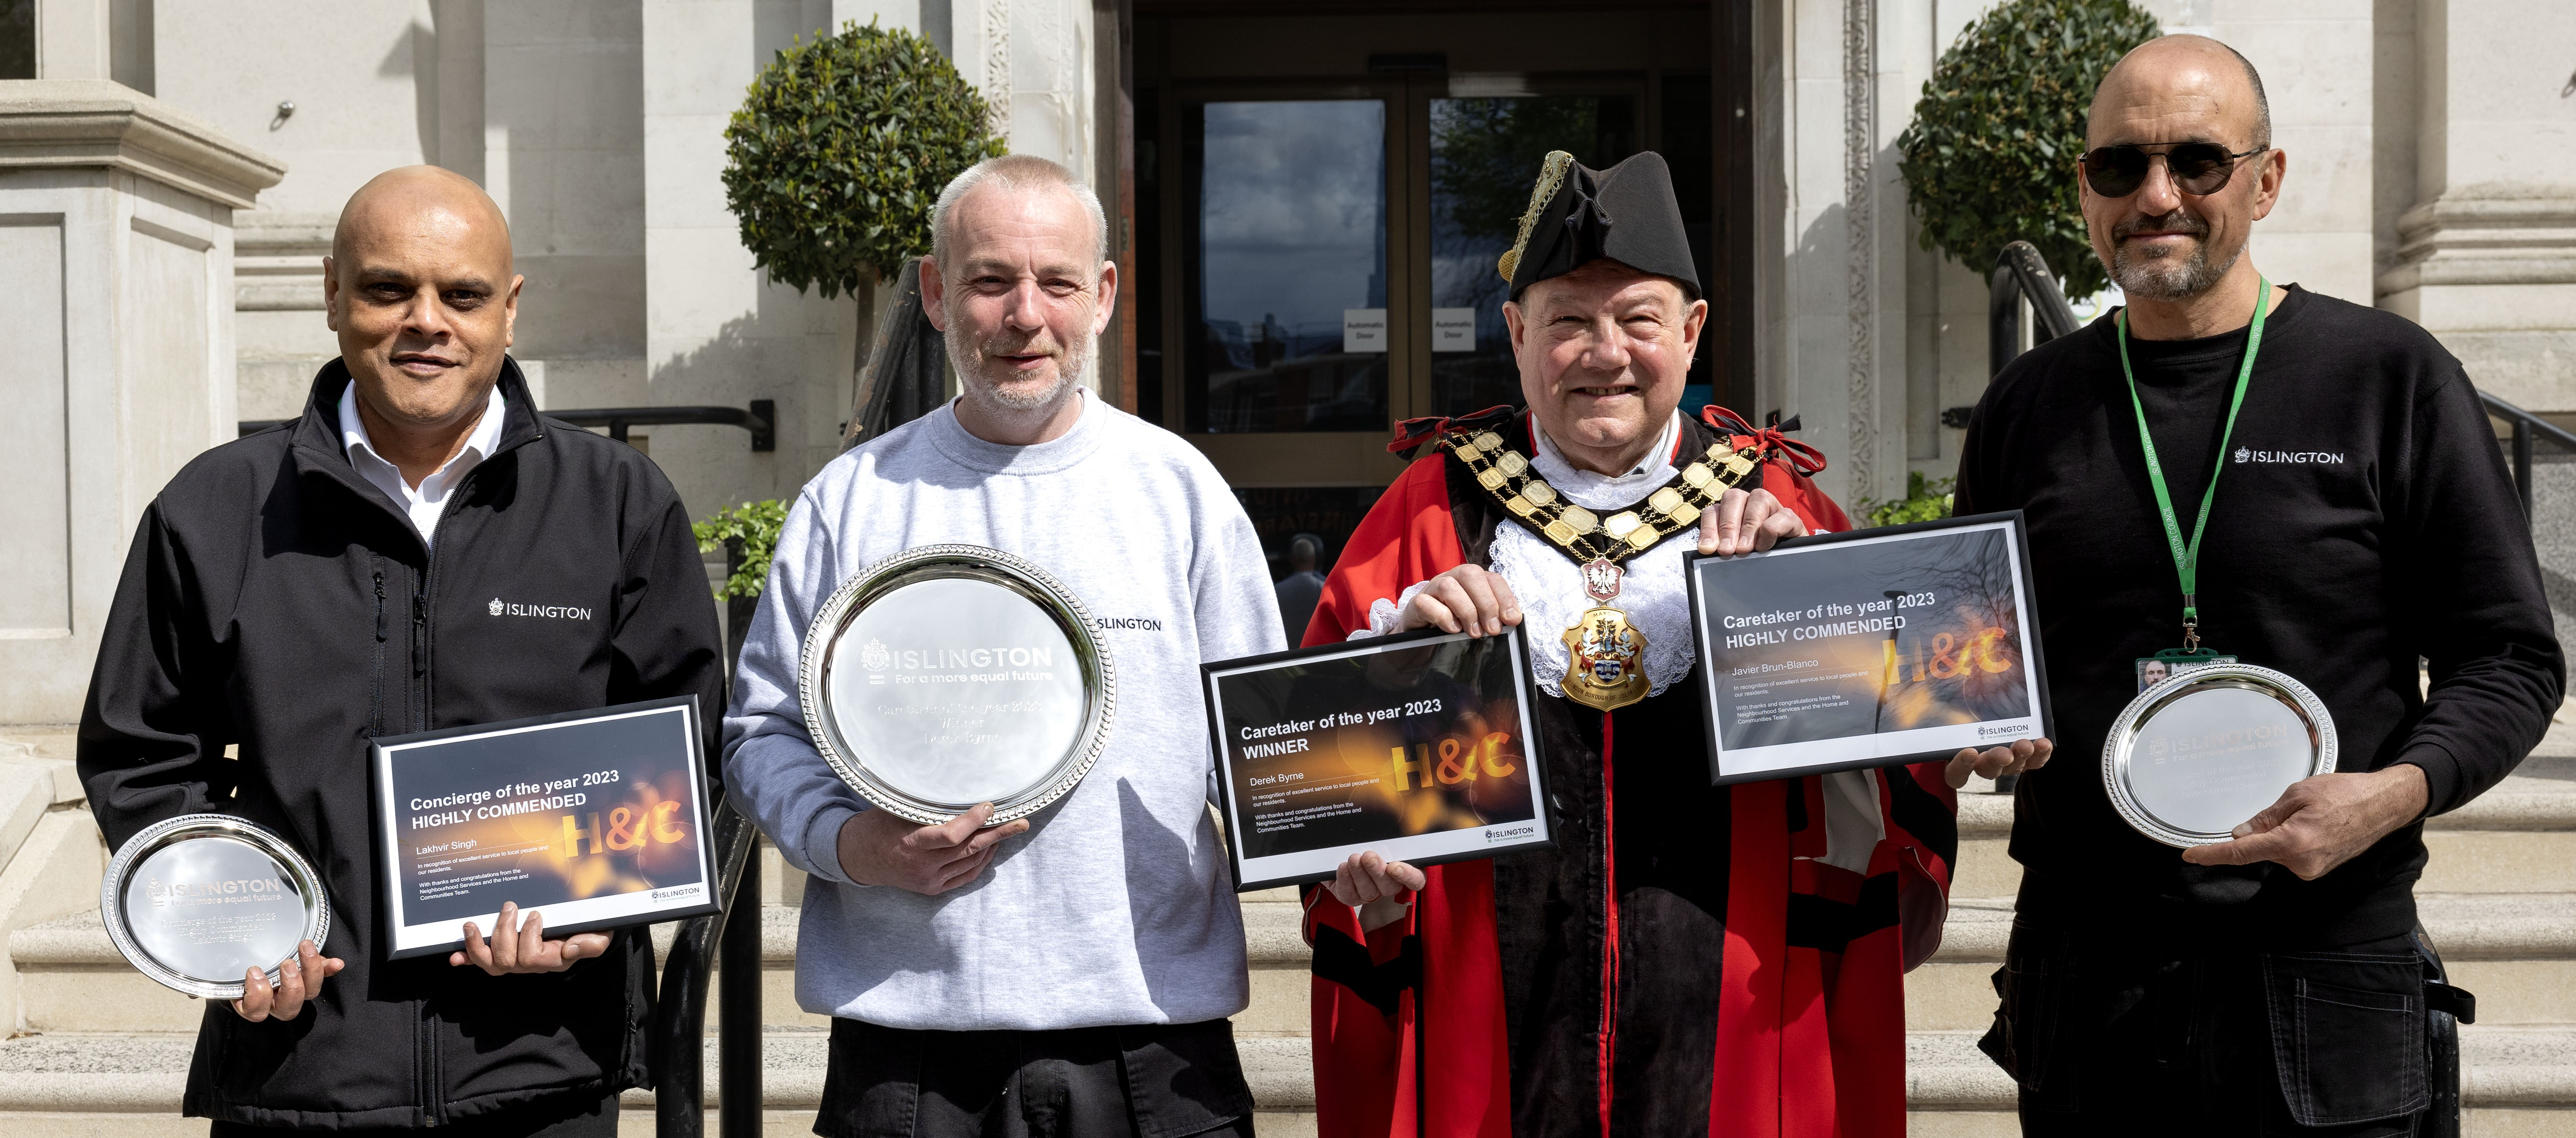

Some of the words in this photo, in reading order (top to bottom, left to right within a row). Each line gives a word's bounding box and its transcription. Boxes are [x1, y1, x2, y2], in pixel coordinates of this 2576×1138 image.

[2146, 444, 2160, 475] ISLINGTON
[2252, 451, 2344, 464] ISLINGTON
[2163, 506, 2177, 535] COUNCIL
[2171, 535, 2186, 570] ISLINGTON
[507, 603, 591, 620] ISLINGTON
[1724, 610, 1801, 628] Caretaker
[1806, 605, 1822, 618] of
[1826, 603, 1852, 616] the
[1856, 600, 1892, 616] year
[1897, 592, 1935, 608] 2023
[1097, 618, 1161, 631] SLINGTON
[1726, 629, 1788, 648] HIGHLY
[1793, 616, 1906, 640] COMMENDED
[894, 647, 1051, 669] ISLINGTON
[1882, 627, 2012, 685] H&C
[1732, 666, 1759, 676] Javier
[1762, 660, 1818, 672] Brun-Blanco
[896, 674, 916, 684] For
[919, 675, 929, 683] a
[932, 673, 968, 683] more
[970, 671, 1009, 684] equal
[1012, 670, 1053, 681] future
[1567, 680, 1585, 694] LONDON
[1585, 691, 1608, 701] BOROUGH
[1620, 683, 1646, 699] ISLINGTON
[1778, 698, 1818, 706] congratulations
[1241, 720, 1315, 740] Caretaker
[1319, 714, 1334, 728] of
[1338, 712, 1363, 725] the
[1366, 707, 1401, 725] year
[1405, 698, 1441, 716] 2023
[1737, 708, 1776, 717] Neighbourhood
[1986, 724, 2029, 735] ISLINGTON
[1242, 738, 1309, 759] WINNER
[1390, 732, 1516, 791] H&C
[1250, 775, 1276, 786] Derek
[1278, 773, 1304, 782] Byrne
[411, 791, 491, 810] Concierge
[496, 784, 511, 798] of
[515, 783, 540, 795] the
[544, 778, 578, 794] year
[582, 770, 619, 786] 2023
[412, 808, 472, 829] HIGHLY
[477, 793, 586, 819] COMMENDED
[1295, 805, 1332, 814] congratulations
[562, 800, 685, 858] H&C
[1256, 816, 1293, 826] Neighbourhood
[1257, 825, 1289, 833] Communities
[1493, 826, 1534, 838] ISLINGTON
[416, 843, 449, 855] Lakhvir
[451, 839, 476, 849] Singh
[460, 872, 499, 881] congratulations
[169, 878, 280, 897] ISLINGTON
[419, 884, 458, 894] Neighbourhood
[659, 887, 699, 898] ISLINGTON
[420, 892, 453, 900] Communities
